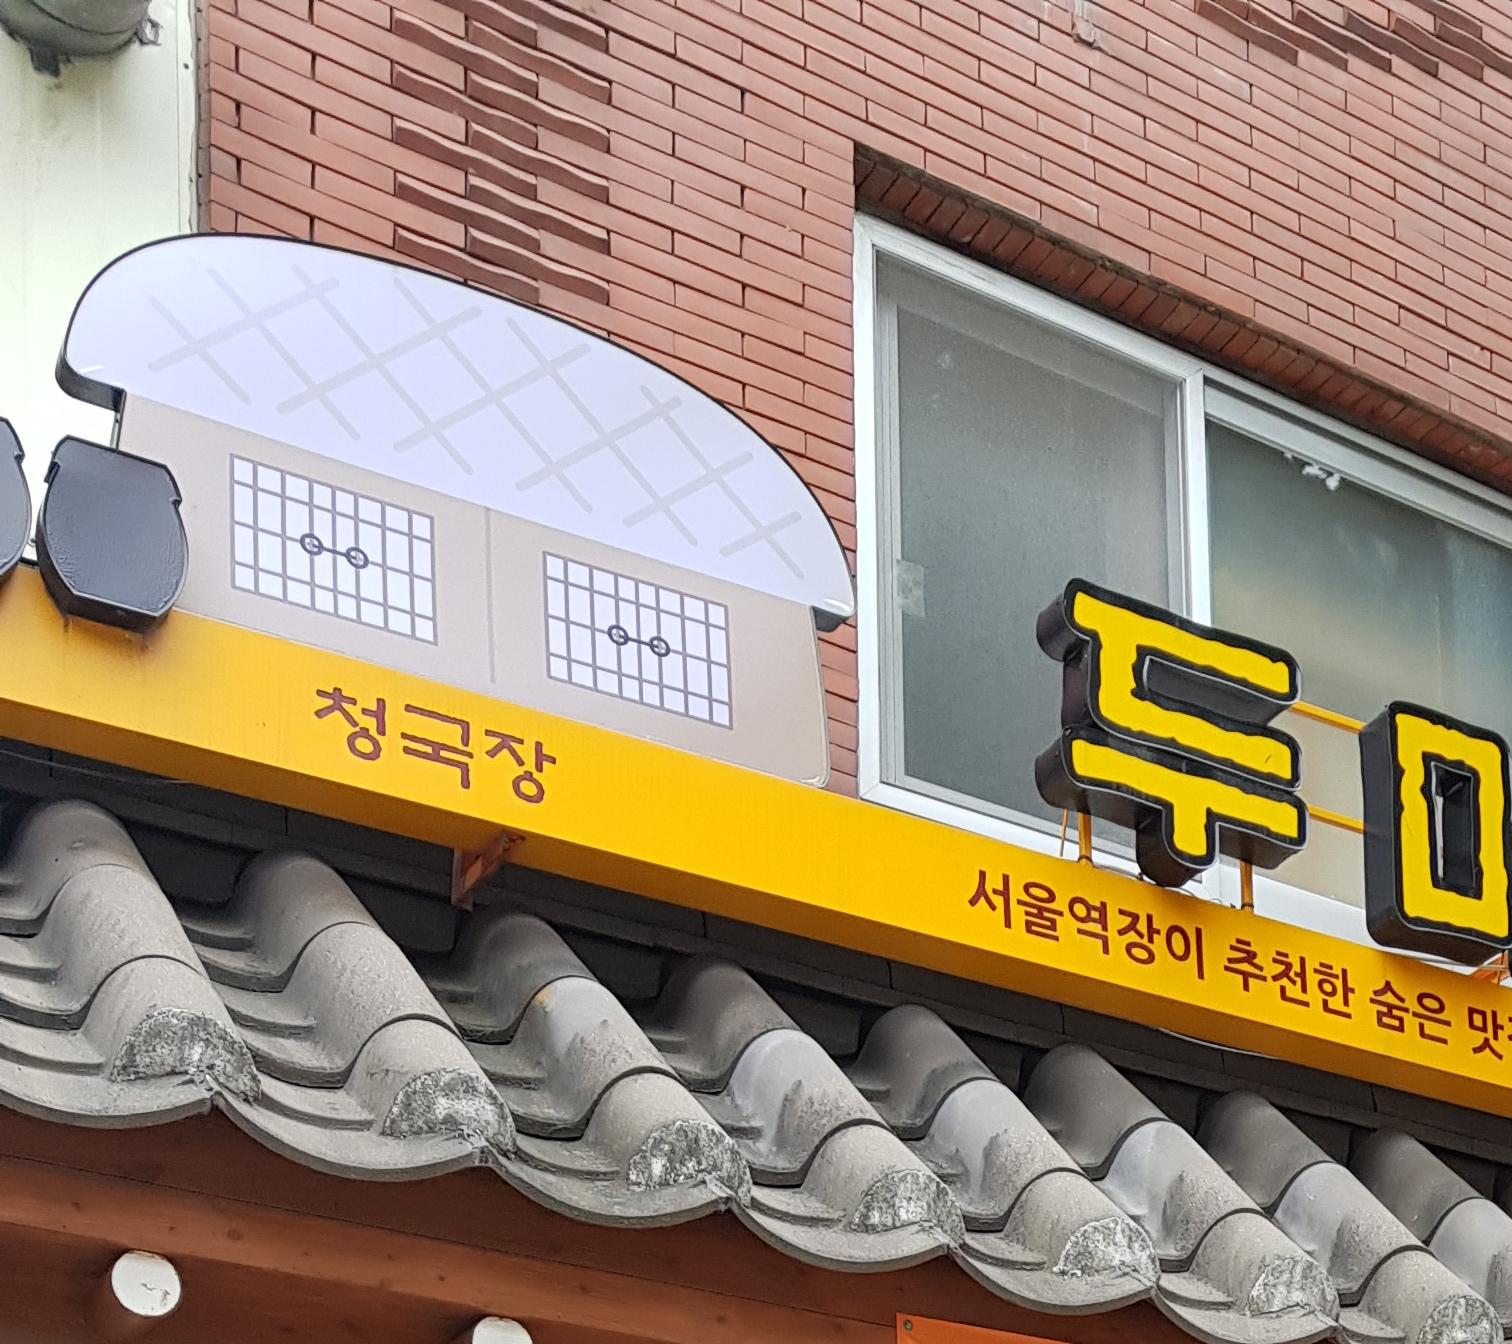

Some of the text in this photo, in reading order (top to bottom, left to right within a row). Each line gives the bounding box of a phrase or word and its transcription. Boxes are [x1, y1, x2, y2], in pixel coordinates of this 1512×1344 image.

[314, 687, 557, 803] 청국장
[967, 868, 1207, 982] 서울역장이
[1223, 937, 1355, 1020] 추천한
[1369, 986, 1452, 1043] 숨은
